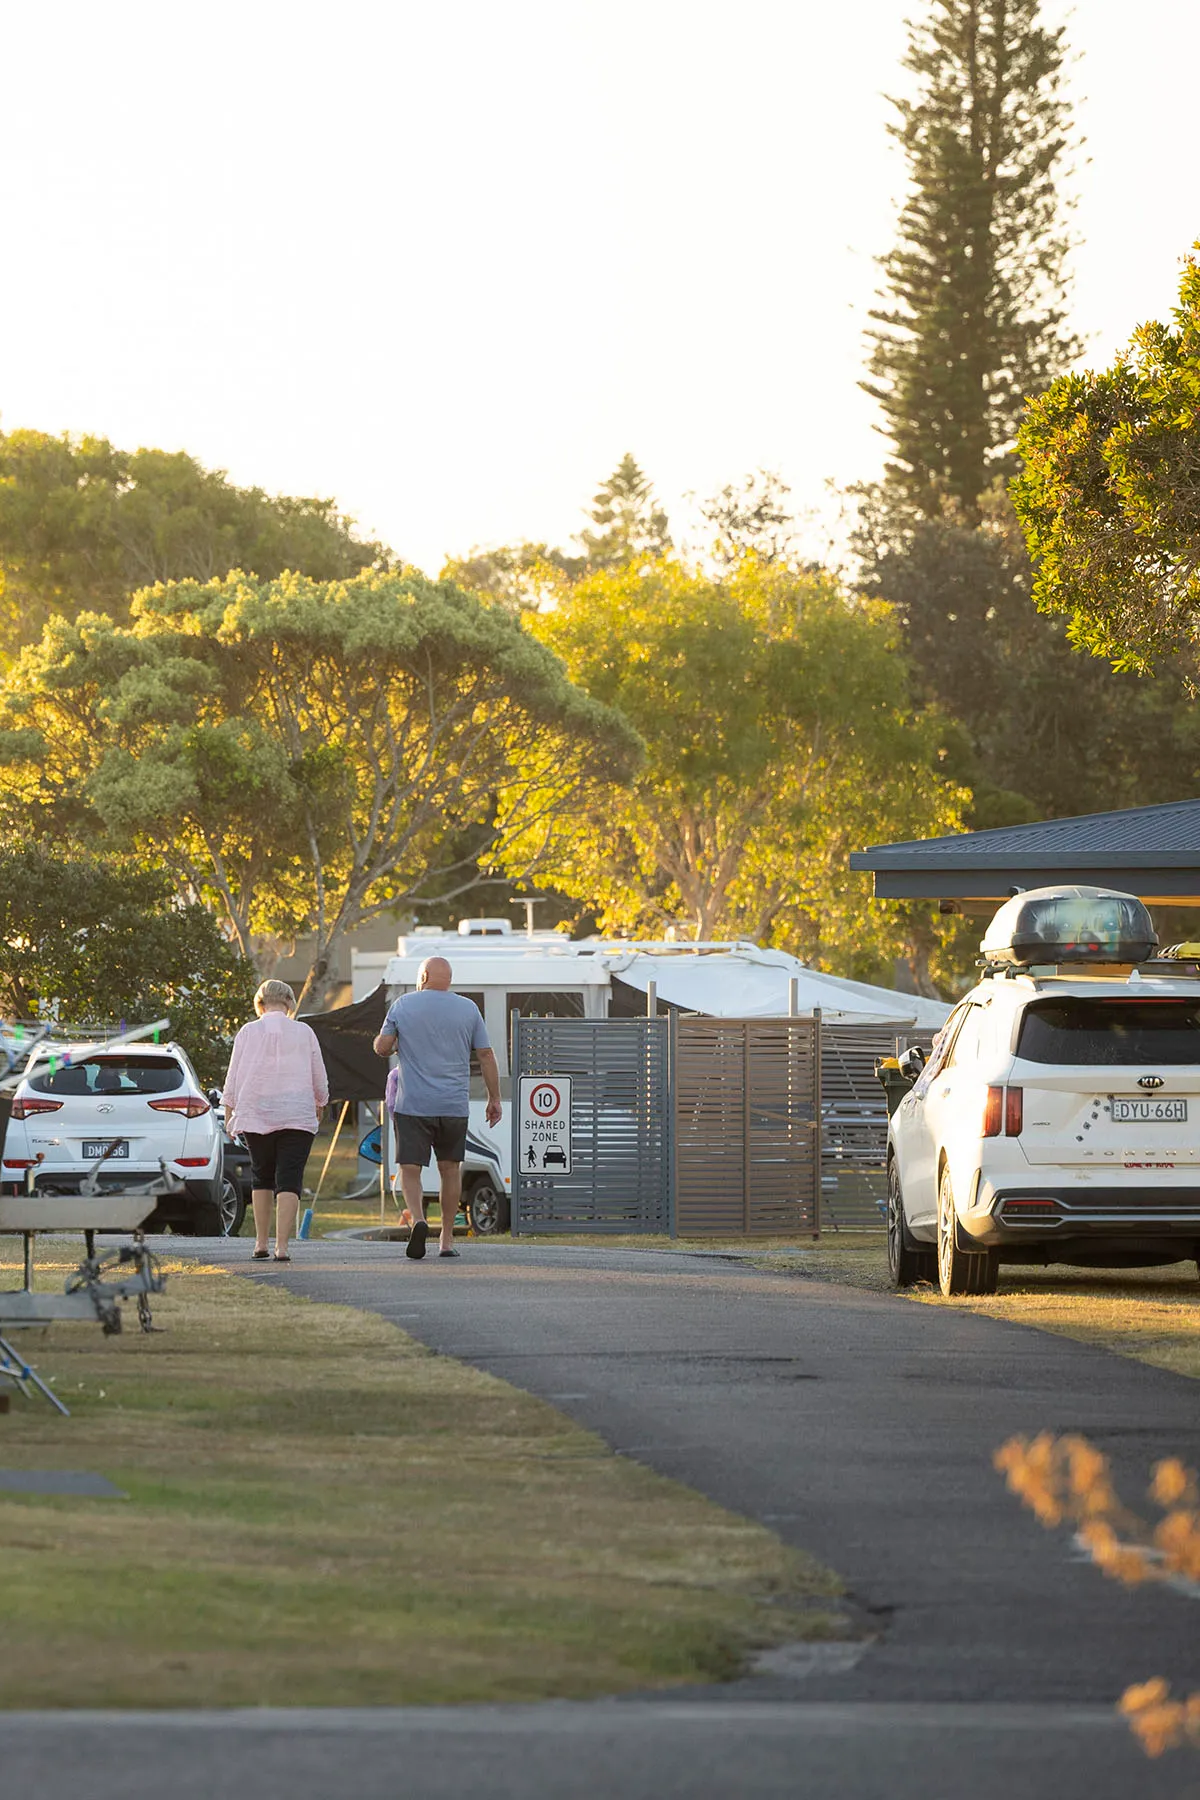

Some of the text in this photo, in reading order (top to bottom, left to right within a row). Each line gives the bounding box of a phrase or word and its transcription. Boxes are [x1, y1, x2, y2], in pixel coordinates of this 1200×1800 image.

[1141, 1078, 1161, 1087] KIA
[538, 1093, 552, 1107] 10
[524, 1120, 566, 1130] SHARED
[532, 1132, 558, 1142] ZONE
